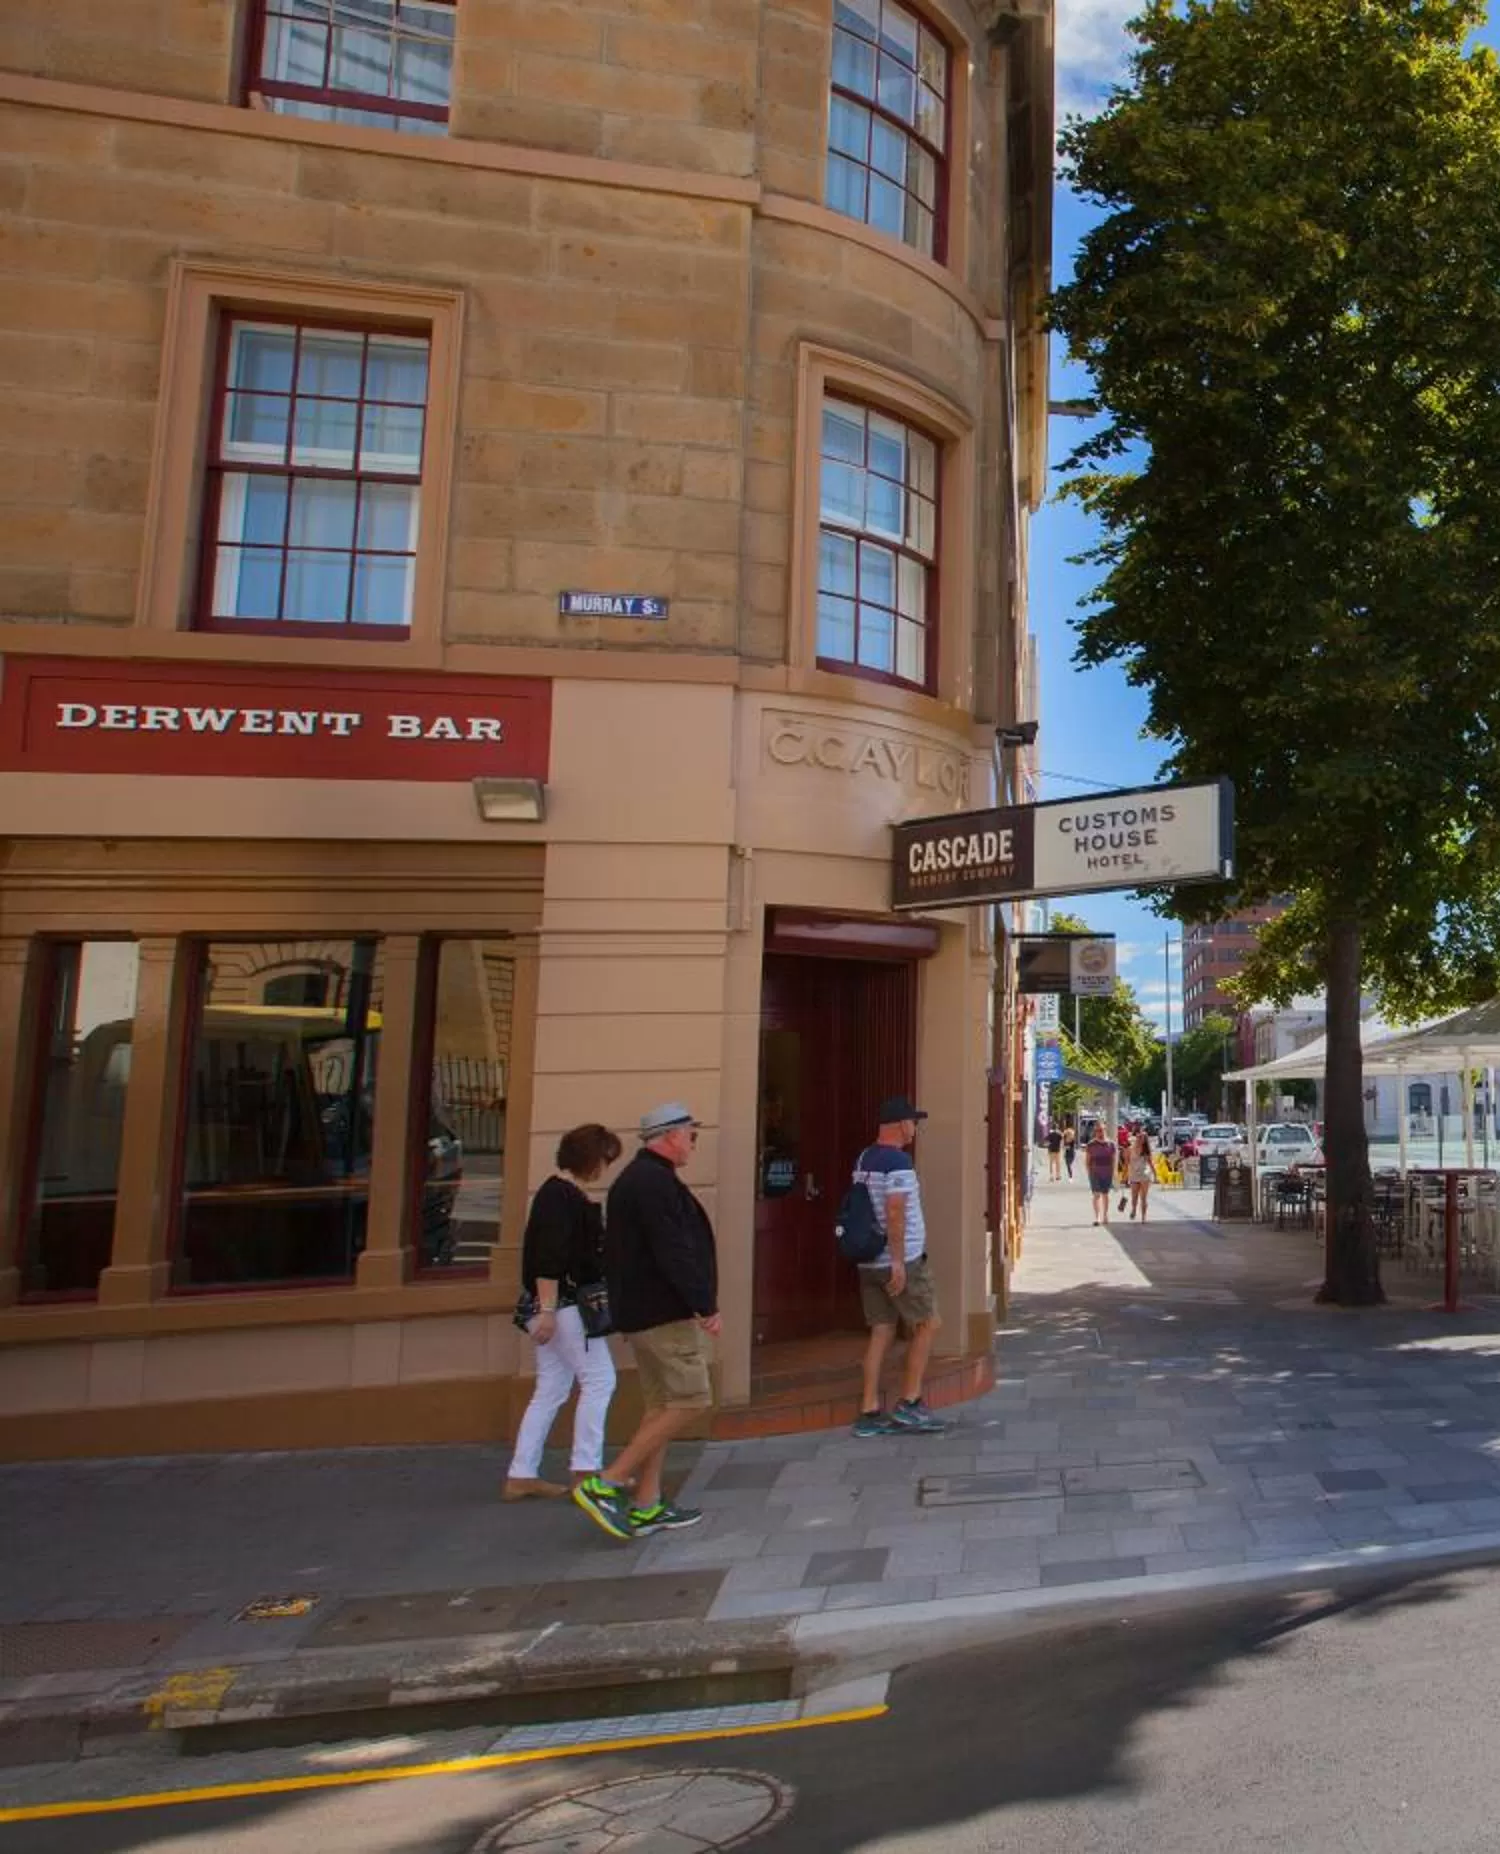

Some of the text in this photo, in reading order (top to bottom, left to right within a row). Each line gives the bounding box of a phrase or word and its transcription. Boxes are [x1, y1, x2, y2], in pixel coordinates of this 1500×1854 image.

[570, 595, 634, 616] MURRAY
[55, 703, 502, 741] DERWENT BAR
[1058, 804, 1176, 833] CUSTOMS
[909, 828, 1014, 873] CASCADE
[1074, 828, 1158, 852] HOUSE
[1087, 853, 1144, 869] HOTEL
